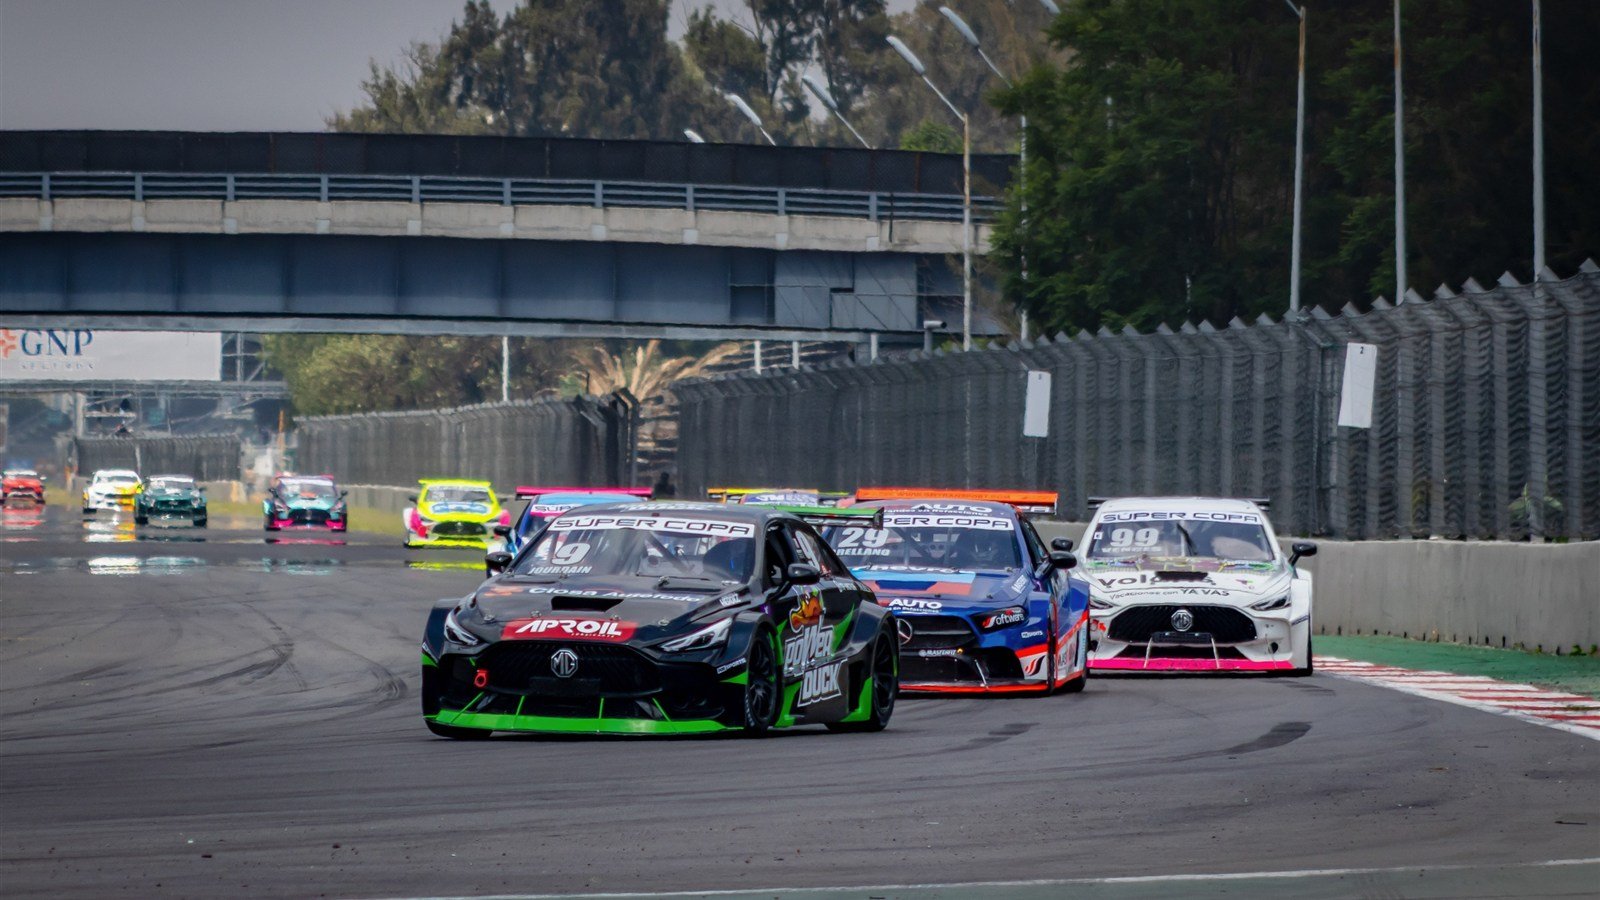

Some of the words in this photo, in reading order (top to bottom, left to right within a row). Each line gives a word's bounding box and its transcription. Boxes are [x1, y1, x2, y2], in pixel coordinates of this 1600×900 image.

[21, 329, 93, 356] GNP
[911, 503, 993, 513] AUTO
[937, 517, 1009, 528] COPA
[1193, 512, 1258, 522] COPA
[664, 520, 750, 535] COPA
[837, 527, 889, 548] 29
[1110, 527, 1159, 547] 99
[835, 548, 891, 556] RELLANO
[1201, 588, 1230, 597] VAS
[888, 598, 943, 610] AUTO
[515, 619, 622, 636] APROIL
[553, 651, 576, 675] MG
[801, 663, 841, 700] DUCK
